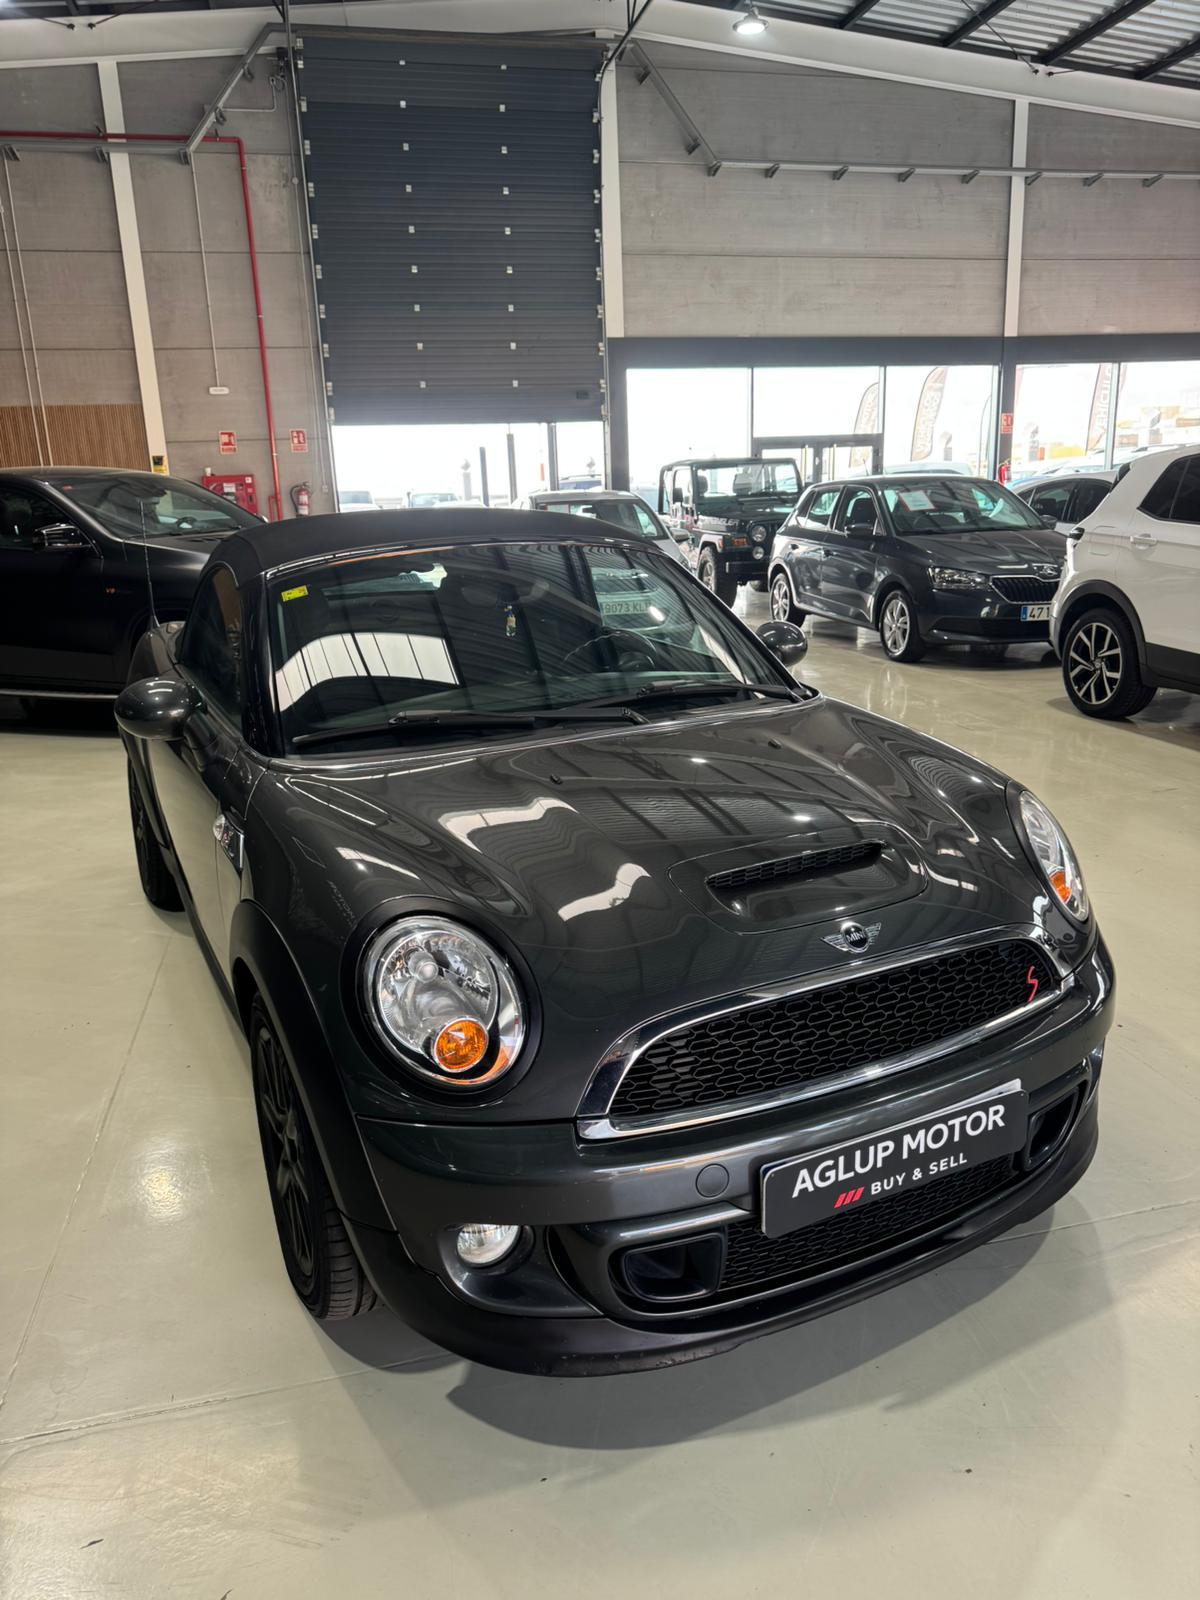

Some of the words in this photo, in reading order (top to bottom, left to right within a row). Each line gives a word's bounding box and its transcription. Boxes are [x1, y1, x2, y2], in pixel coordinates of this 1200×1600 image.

[791, 1140, 895, 1198] AGLUP
[902, 1104, 1006, 1160] MOTOR
[871, 1172, 907, 1196] BUY
[911, 1167, 923, 1181] &
[929, 1153, 968, 1176] SELL
